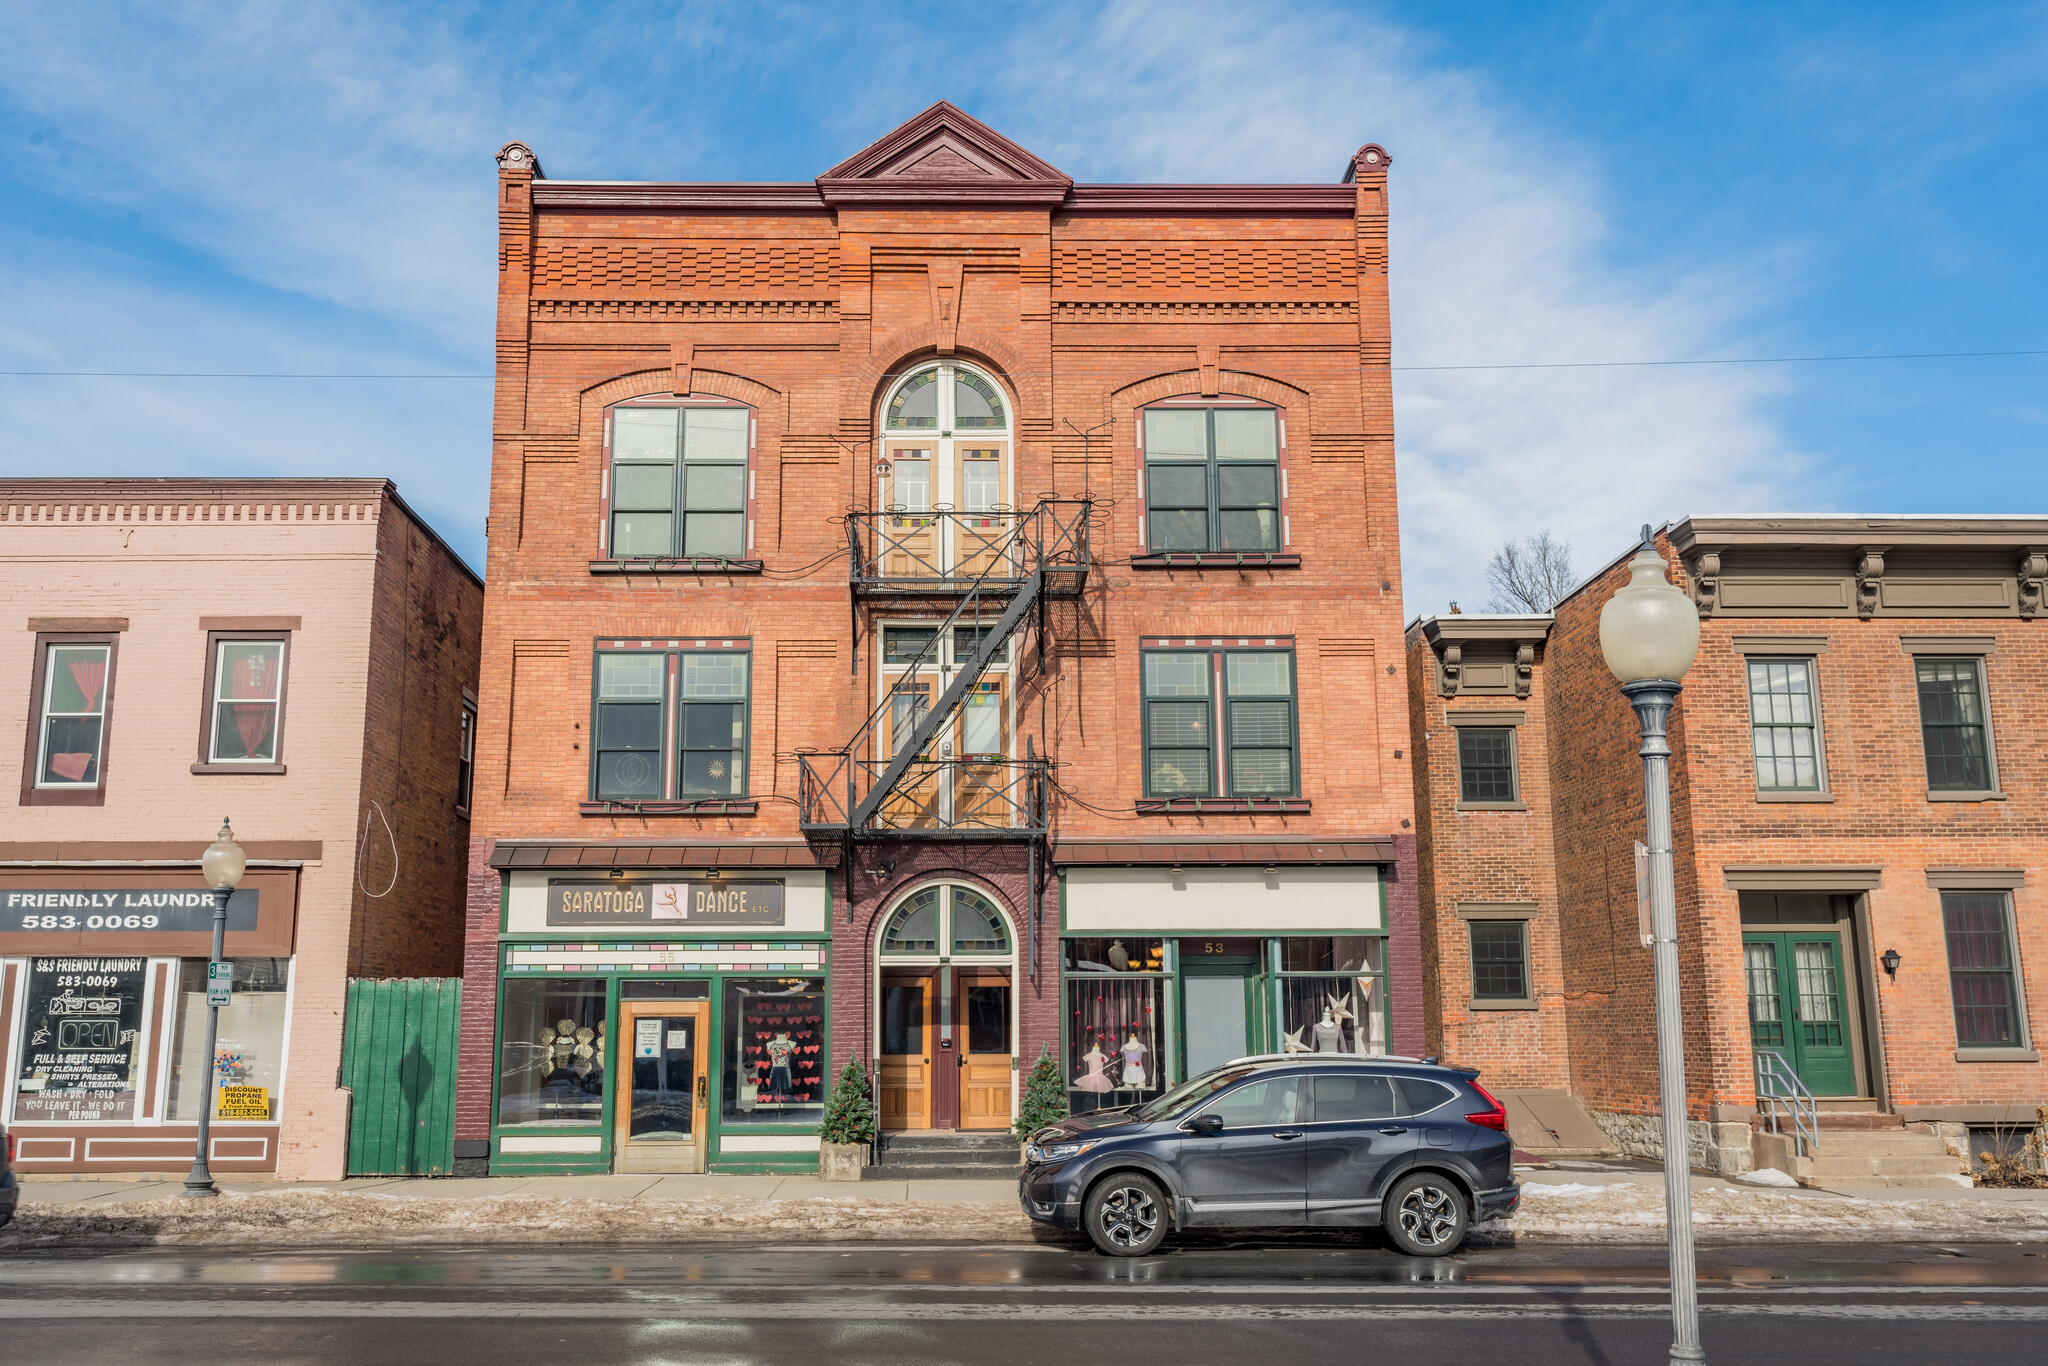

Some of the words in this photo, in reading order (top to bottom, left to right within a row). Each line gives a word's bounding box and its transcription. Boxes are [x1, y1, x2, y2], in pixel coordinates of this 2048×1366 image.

[8, 893, 118, 907] FRIENDLY
[124, 893, 215, 907] LAUNDR
[562, 890, 645, 913] SARATOGA
[695, 890, 748, 913] DANCE
[1205, 942, 1224, 953] 53
[659, 952, 675, 963] 55
[36, 958, 55, 973] S&S
[56, 958, 99, 973] FRIENDLY
[100, 957, 142, 973] LAUNDRY
[210, 965, 216, 977] 3
[56, 975, 118, 987] 583-0069
[62, 1022, 116, 1047] OPEN
[33, 1054, 56, 1064] FULL
[57, 1054, 64, 1063] &
[64, 1054, 88, 1064] SELF
[88, 1054, 127, 1064] SERVICE
[52, 1065, 93, 1073] CLEANING
[38, 1089, 62, 1099] WASH
[69, 1090, 86, 1099] DRY
[94, 1090, 115, 1099] FOLD
[25, 1100, 43, 1110] YOU
[44, 1101, 70, 1111] LEAVE
[72, 1101, 80, 1111] IT
[88, 1101, 101, 1111] WE
[102, 1101, 115, 1111] DO
[116, 1101, 126, 1111] IT
[50, 1110, 55, 1120] $
[68, 1110, 80, 1120] PER
[80, 1110, 101, 1120] POUND
